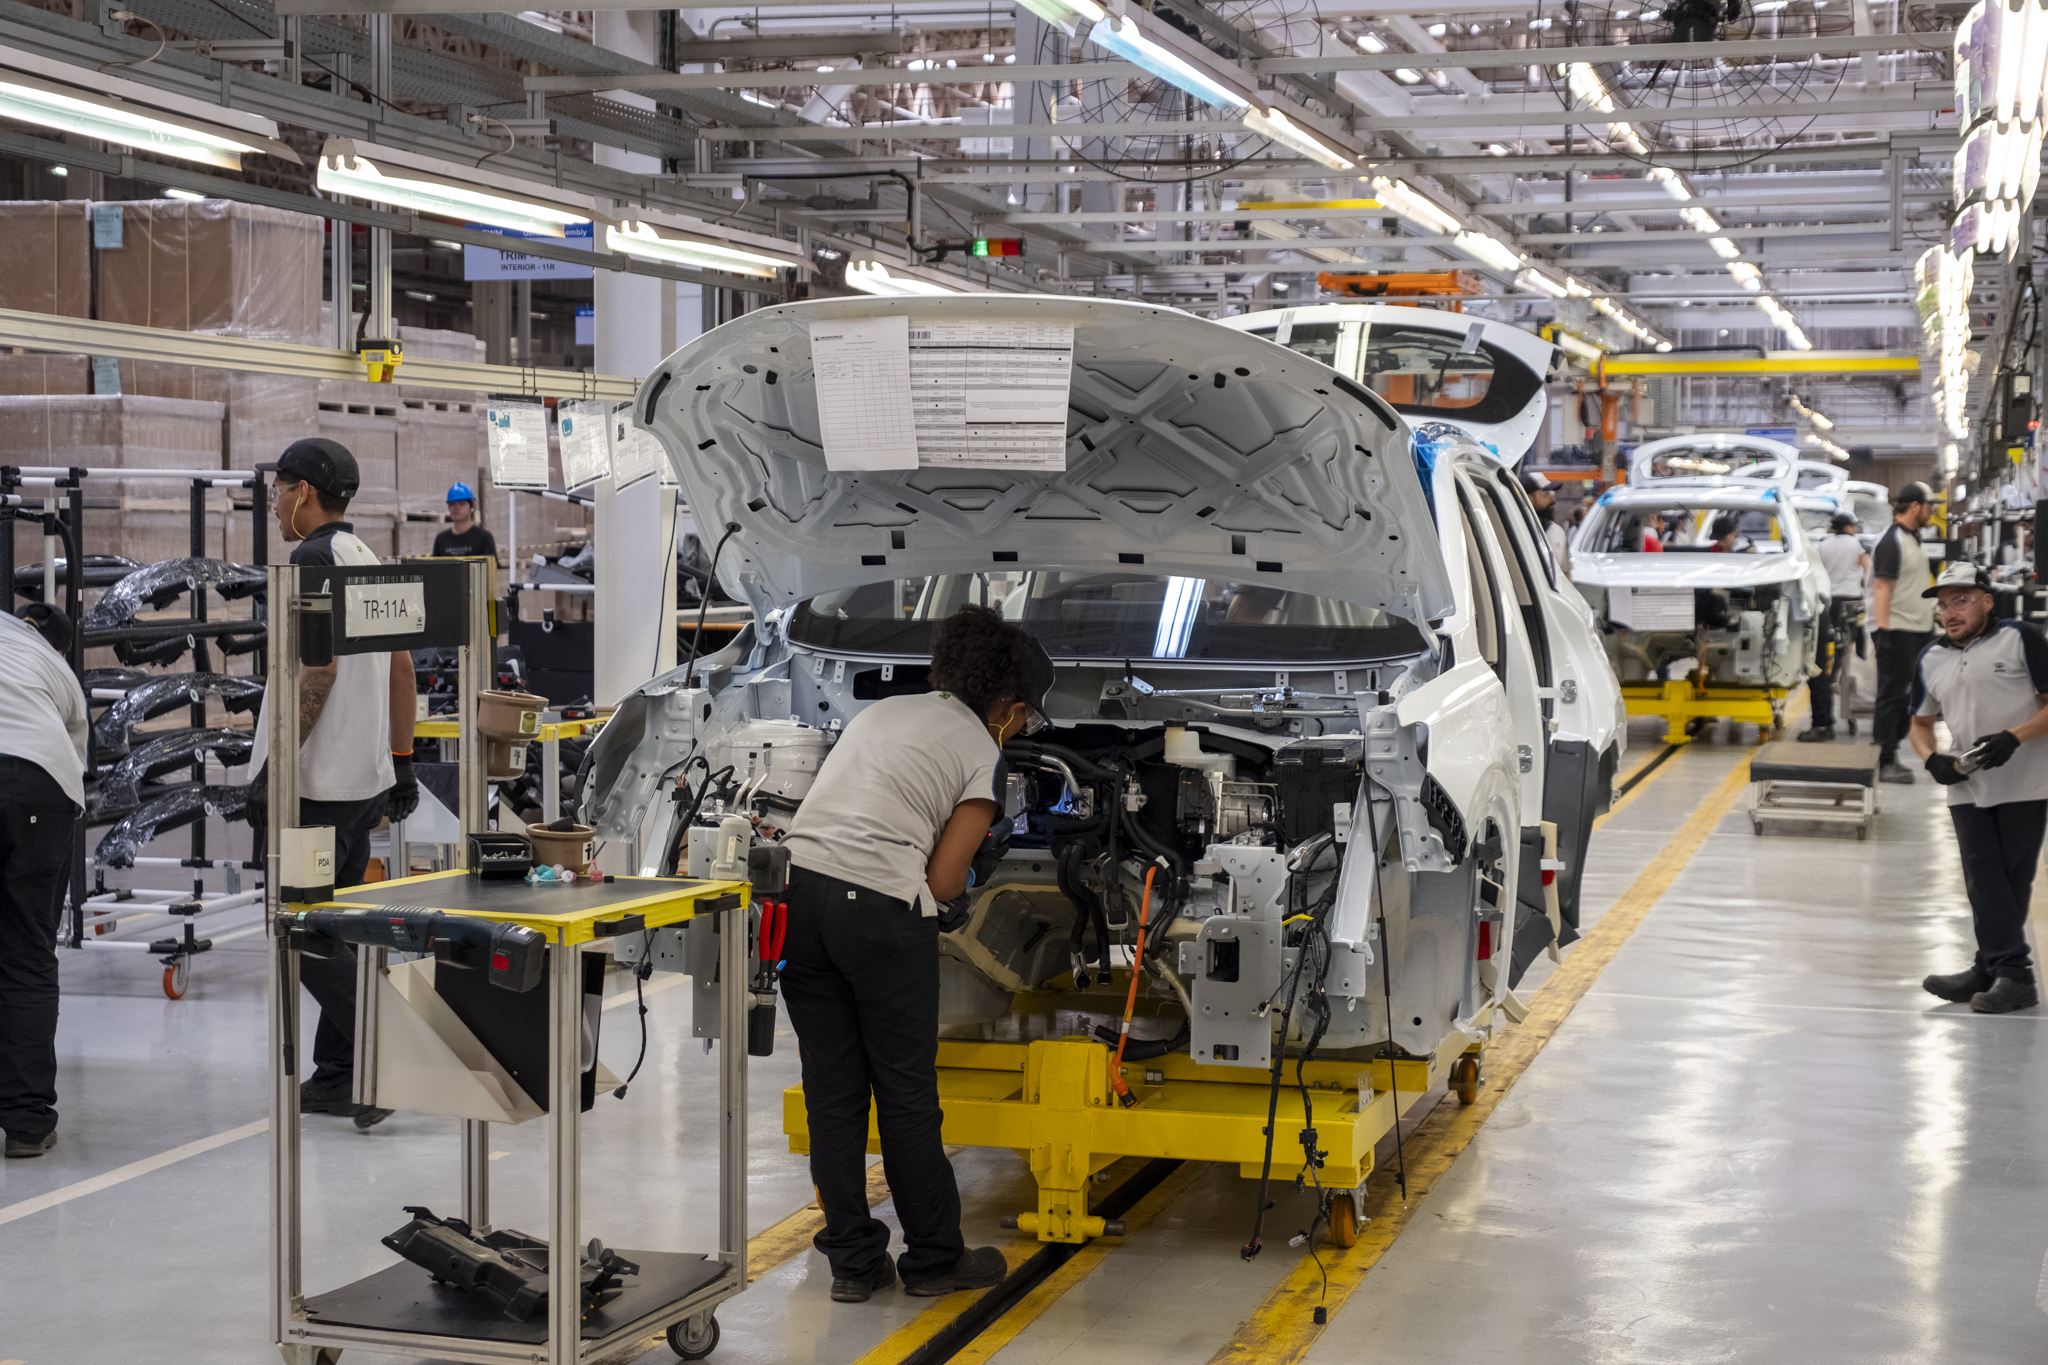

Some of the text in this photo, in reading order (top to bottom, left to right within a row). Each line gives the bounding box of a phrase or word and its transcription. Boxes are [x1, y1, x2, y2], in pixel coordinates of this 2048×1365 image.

[566, 228, 587, 237] embly
[500, 263, 536, 271] INTERIOR
[542, 263, 555, 271] 11R
[363, 598, 408, 620] TR-11A
[318, 858, 330, 867] PDA
